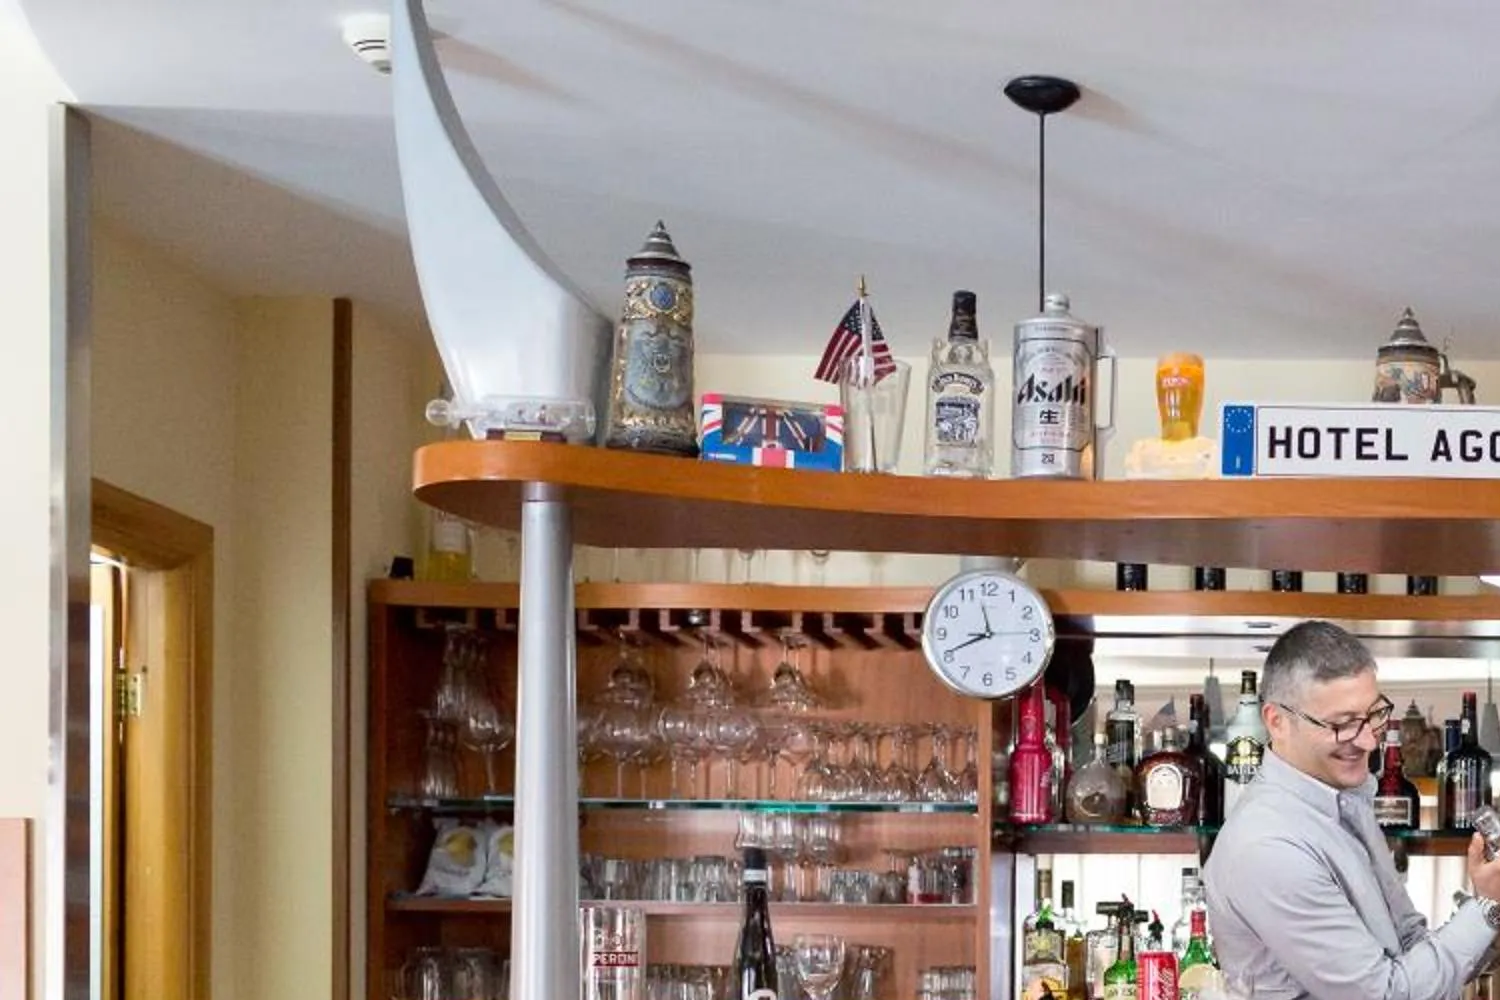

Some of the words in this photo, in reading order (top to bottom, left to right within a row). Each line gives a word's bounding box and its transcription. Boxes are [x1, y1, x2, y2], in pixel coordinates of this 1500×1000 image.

[1018, 373, 1086, 405] Asahi
[1040, 409, 1059, 425] 生
[1268, 426, 1408, 460] HOTEL
[959, 589, 974, 601] 11
[981, 582, 999, 597] 12
[1008, 590, 1015, 602] 1
[943, 605, 959, 619] 10
[1021, 605, 1033, 620] 2
[936, 628, 947, 640] 9
[1029, 628, 1041, 643] 3
[943, 650, 955, 663] 8
[1022, 652, 1032, 664] 4
[960, 666, 970, 679] 7
[982, 672, 993, 687] 6
[1005, 667, 1017, 680] 5
